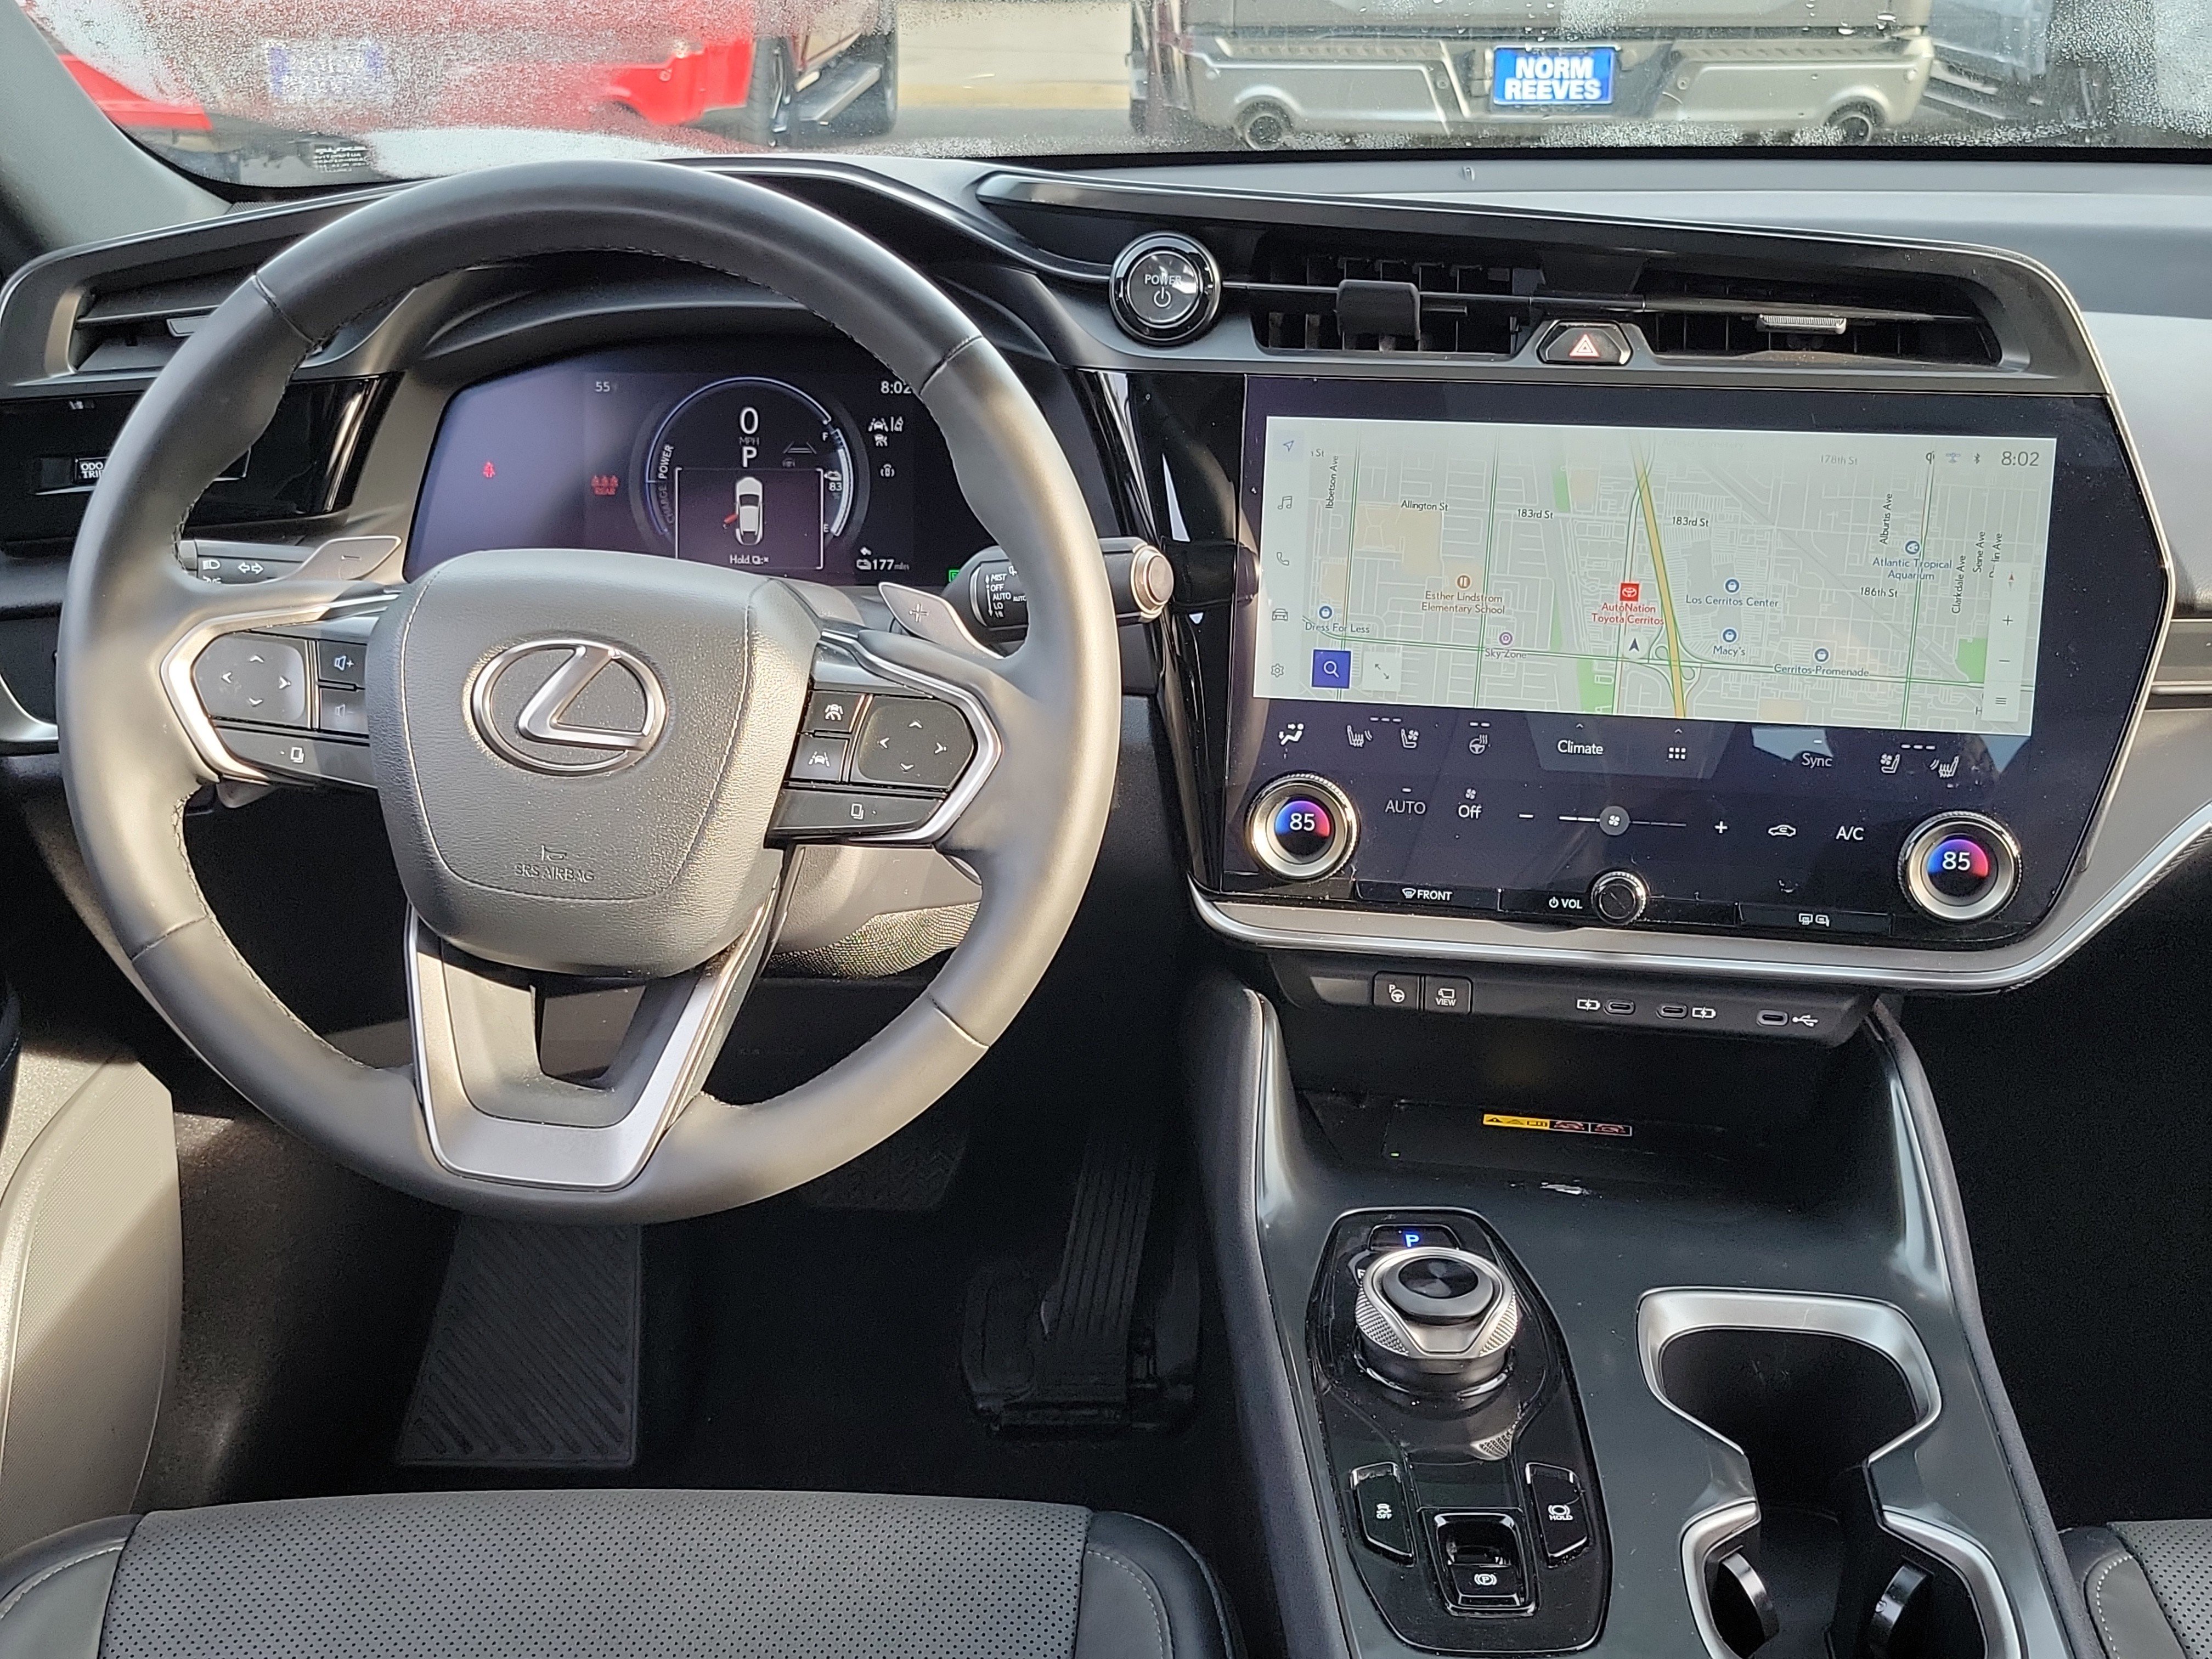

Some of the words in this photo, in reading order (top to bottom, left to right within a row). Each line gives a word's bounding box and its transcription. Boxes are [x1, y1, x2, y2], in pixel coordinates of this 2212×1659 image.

[1515, 57, 1594, 80] NORM
[1505, 79, 1602, 100] REEVES
[1145, 274, 1182, 285] POWER
[595, 382, 610, 392] 55
[881, 382, 912, 394] 8:02
[740, 407, 759, 435] 0
[742, 446, 757, 467] P
[1316, 449, 1324, 457] St
[2001, 450, 2040, 466] 8:02
[658, 444, 674, 479] POWER
[1329, 455, 1339, 472] Ave
[1821, 454, 1846, 464] 178th
[1849, 456, 1858, 465] St
[81, 462, 103, 470] ODO
[829, 482, 842, 491] 83
[1325, 473, 1337, 509] Ibbetson
[1401, 500, 1437, 511] Allington
[1440, 502, 1448, 511] St
[1883, 493, 1893, 511] Ave
[1517, 509, 1542, 519] 183rd
[1544, 510, 1553, 520] St
[1672, 516, 1697, 527] 183rd
[1699, 517, 1709, 527] St
[1880, 513, 1891, 545] Alburtis
[1976, 531, 1985, 549] Ave
[1992, 533, 2002, 550] Ave
[730, 554, 750, 564] Hold
[873, 558, 894, 570] 177
[1873, 557, 1910, 567] Atlantic
[1913, 558, 1952, 571] Tropical
[1956, 555, 1966, 572] Ave
[991, 573, 1007, 582] MIST
[1888, 570, 1934, 581] Aquarium
[990, 584, 1005, 592] OFF
[1860, 587, 1886, 597] 186th
[1888, 588, 1898, 597] St
[1951, 574, 1964, 614] Clarkdale
[992, 592, 1011, 601] AUTO
[1425, 591, 1454, 601] Esther
[1457, 592, 1503, 603] Lindstrom
[1686, 595, 1702, 605] Los
[1705, 596, 1743, 606] Cerritos
[1746, 597, 1779, 607] Center
[993, 602, 1003, 610] LO
[1421, 603, 1472, 614] Elementary
[1475, 604, 1505, 614] School
[1601, 603, 1656, 613] AutoNation
[1592, 614, 1624, 625] Toyota
[1627, 615, 1664, 625] Cerritos
[1305, 622, 1329, 631] Dress
[1333, 623, 1347, 631] For
[1350, 624, 1370, 633] Less
[1485, 648, 1500, 659] Sky
[1504, 650, 1527, 658] Zone
[1713, 646, 1746, 657] Macy's
[1774, 663, 1811, 674] Cerritos
[1815, 665, 1869, 677] Promenade
[1558, 740, 1604, 756] Climate
[1802, 753, 1833, 768] Sync
[1385, 800, 1426, 815] AUTO
[1458, 804, 1482, 819] Off
[1289, 813, 1315, 832] 85
[1836, 827, 1864, 840] A/C
[1942, 852, 1971, 871] 85
[515, 863, 540, 877] SRS
[543, 866, 595, 883] AIRBAG
[1417, 890, 1452, 901] FRONT
[1561, 898, 1583, 909] VOL
[1436, 998, 1457, 1007] VIEW
[1406, 1234, 1420, 1247] P
